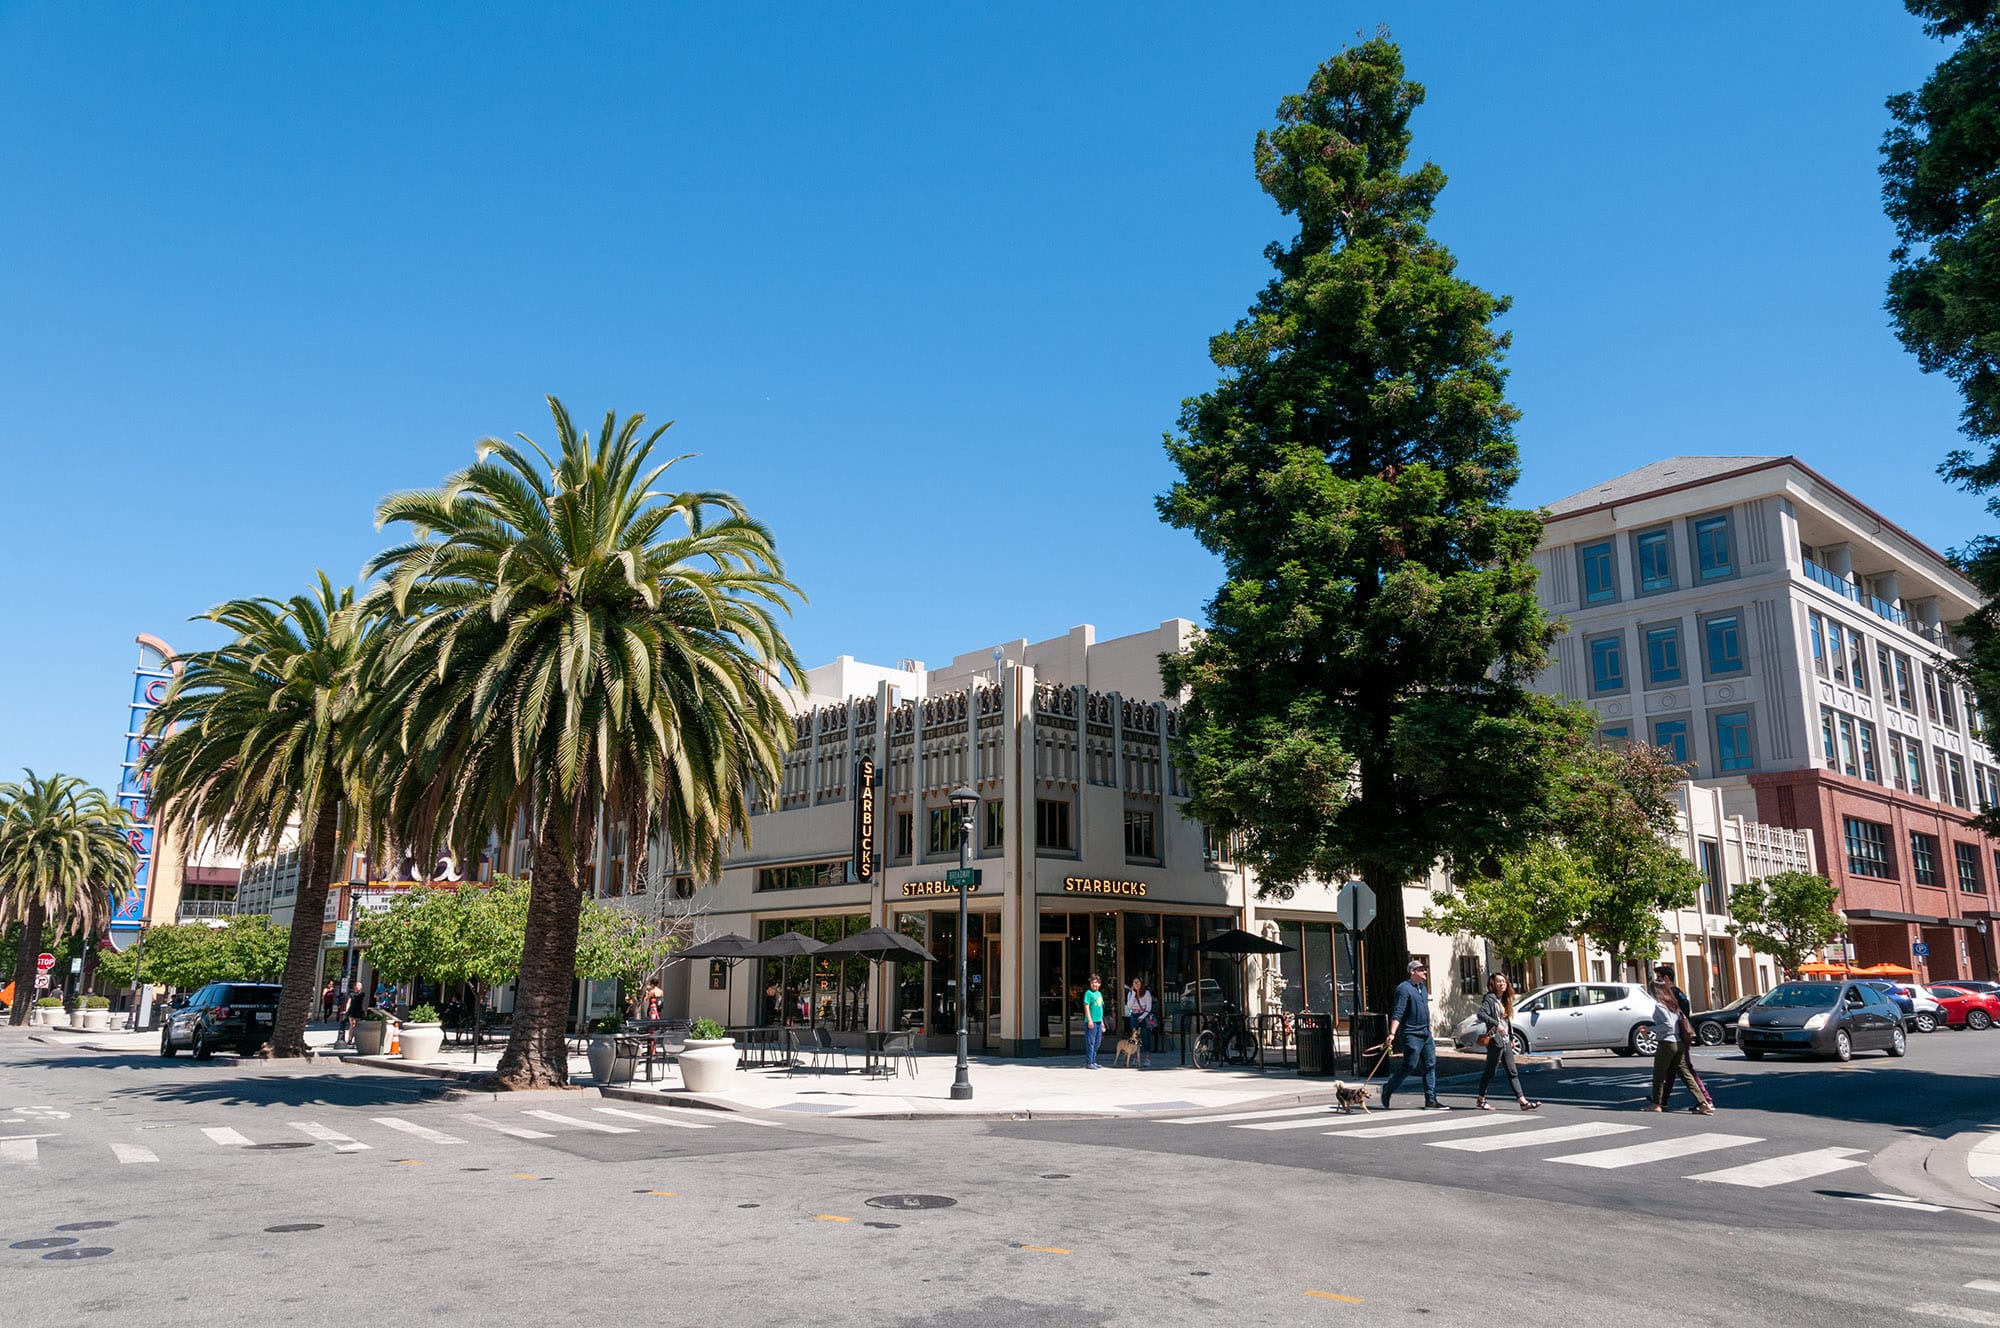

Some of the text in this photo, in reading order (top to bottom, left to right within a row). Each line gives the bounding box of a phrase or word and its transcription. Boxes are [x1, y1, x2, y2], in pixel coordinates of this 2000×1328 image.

[127, 680, 167, 884] CNTURY
[862, 761, 873, 877] STARBUCKS
[903, 880, 976, 896] STARBUCS
[1066, 877, 1146, 896] STARBUCKS
[38, 958, 54, 966] STOP
